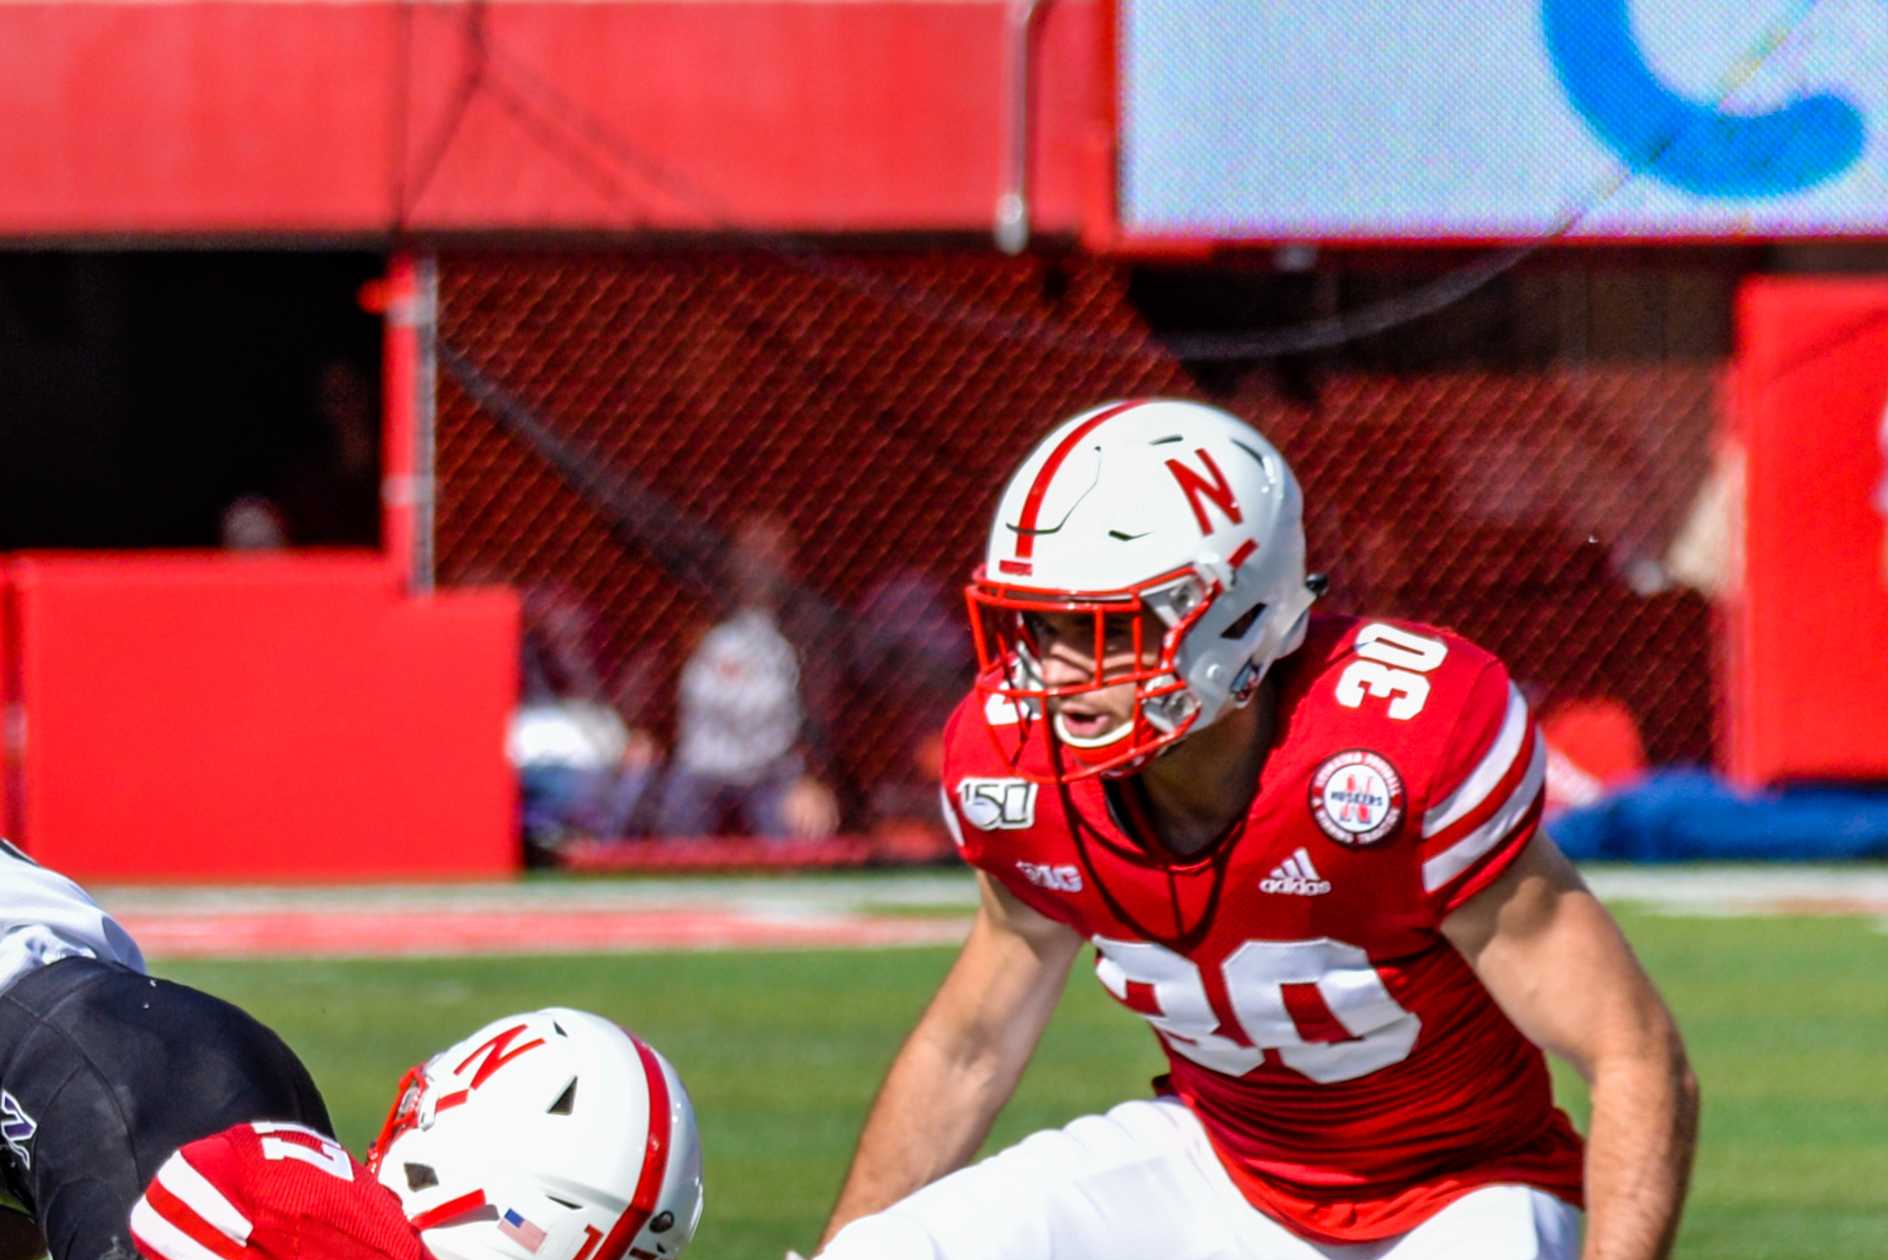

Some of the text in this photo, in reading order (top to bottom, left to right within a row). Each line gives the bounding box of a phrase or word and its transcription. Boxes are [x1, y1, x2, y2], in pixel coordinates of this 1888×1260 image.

[1165, 448, 1244, 536] N
[1336, 622, 1449, 721] 30
[1258, 878, 1331, 896] adidas
[1091, 935, 1422, 1084] 30
[453, 1023, 546, 1090] N
